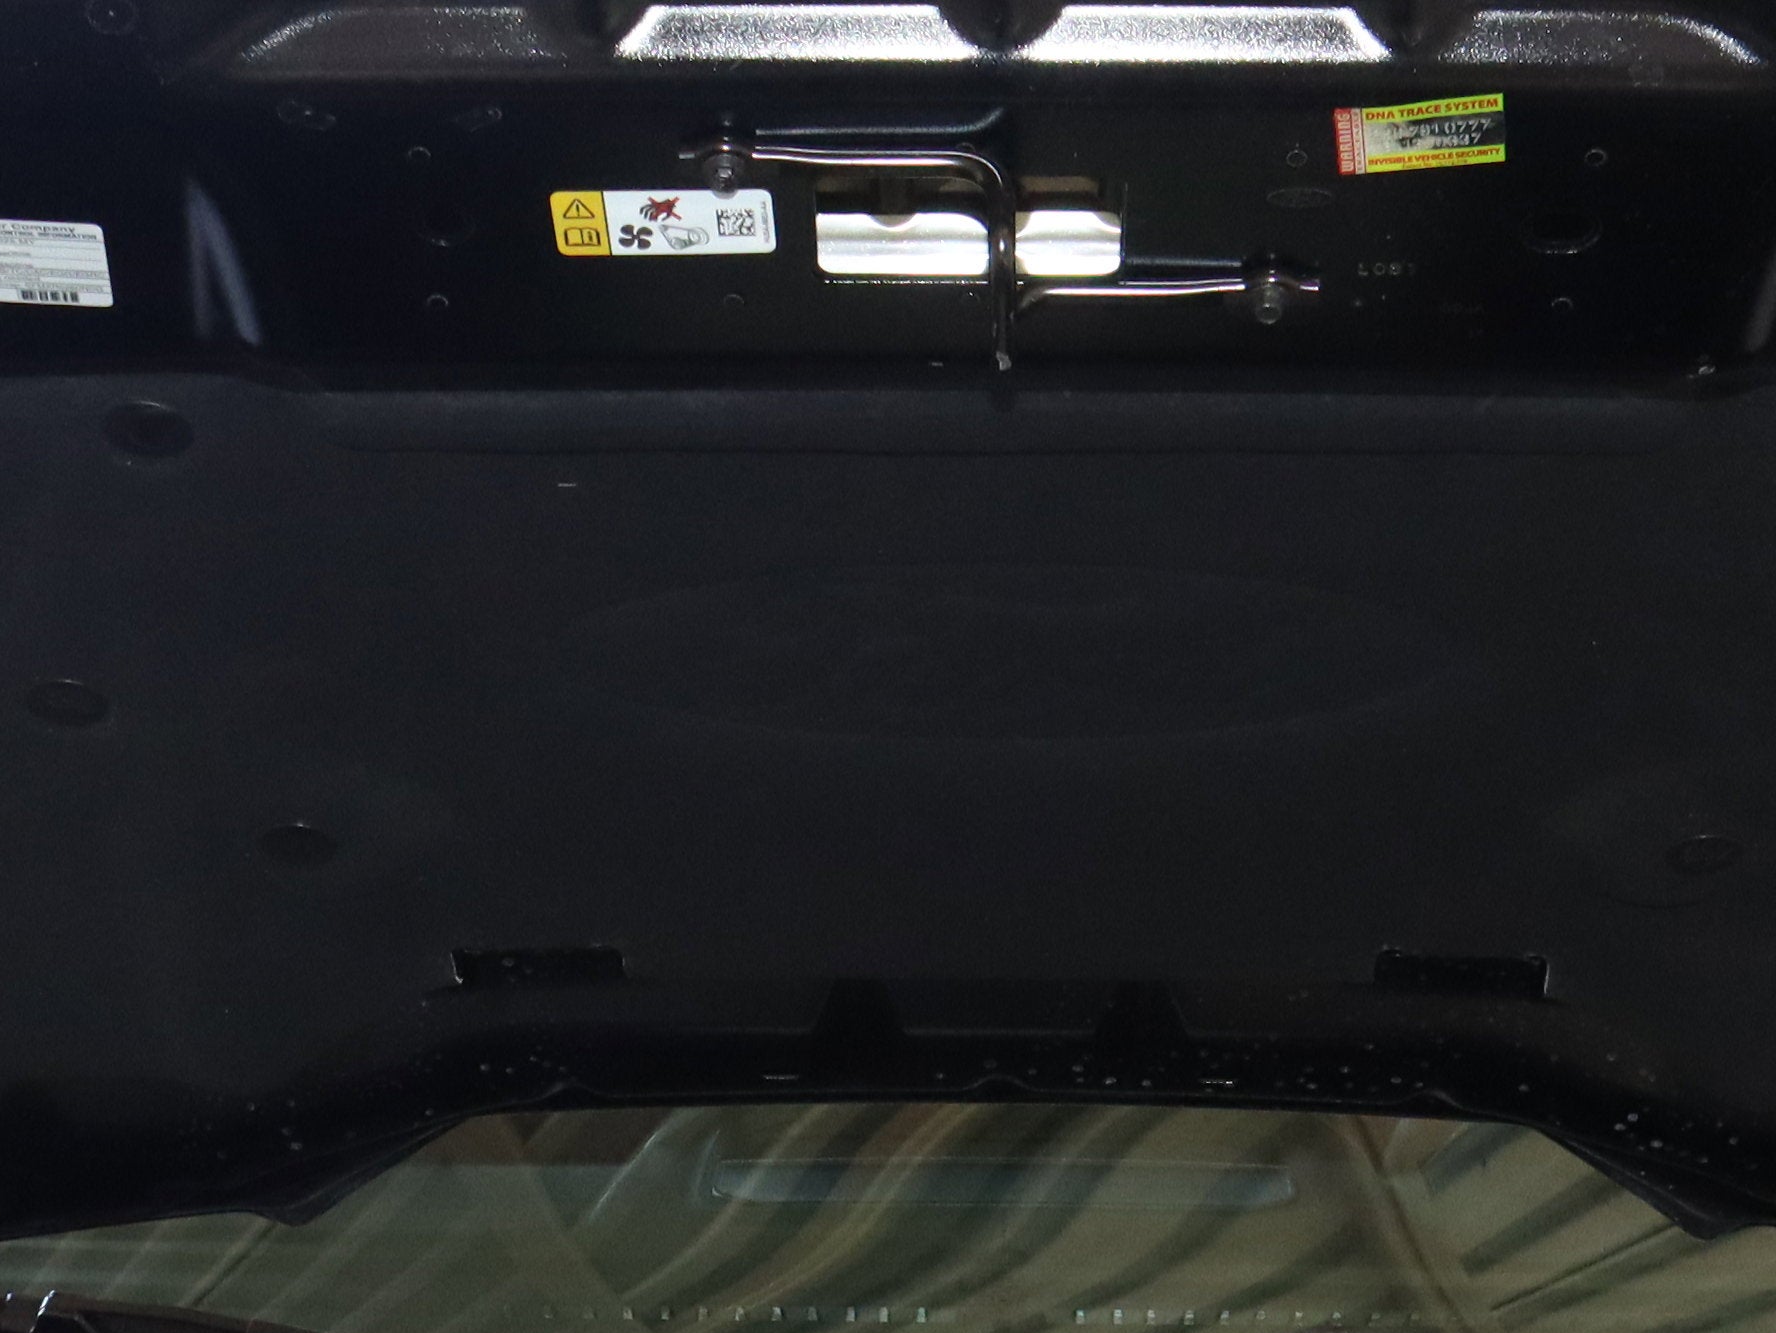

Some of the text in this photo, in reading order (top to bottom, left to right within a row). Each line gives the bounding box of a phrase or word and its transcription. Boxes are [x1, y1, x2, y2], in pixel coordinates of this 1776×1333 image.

[1365, 98, 1499, 121] DNA TRACE SYSTEM
[1338, 112, 1354, 172] WARNING
[1367, 155, 1414, 165] INVISIBLE
[1414, 152, 1453, 162] VEHICLE
[1455, 148, 1501, 159] SECURITY
[12, 223, 75, 233] Company
[38, 232, 96, 240] INFORMATION
